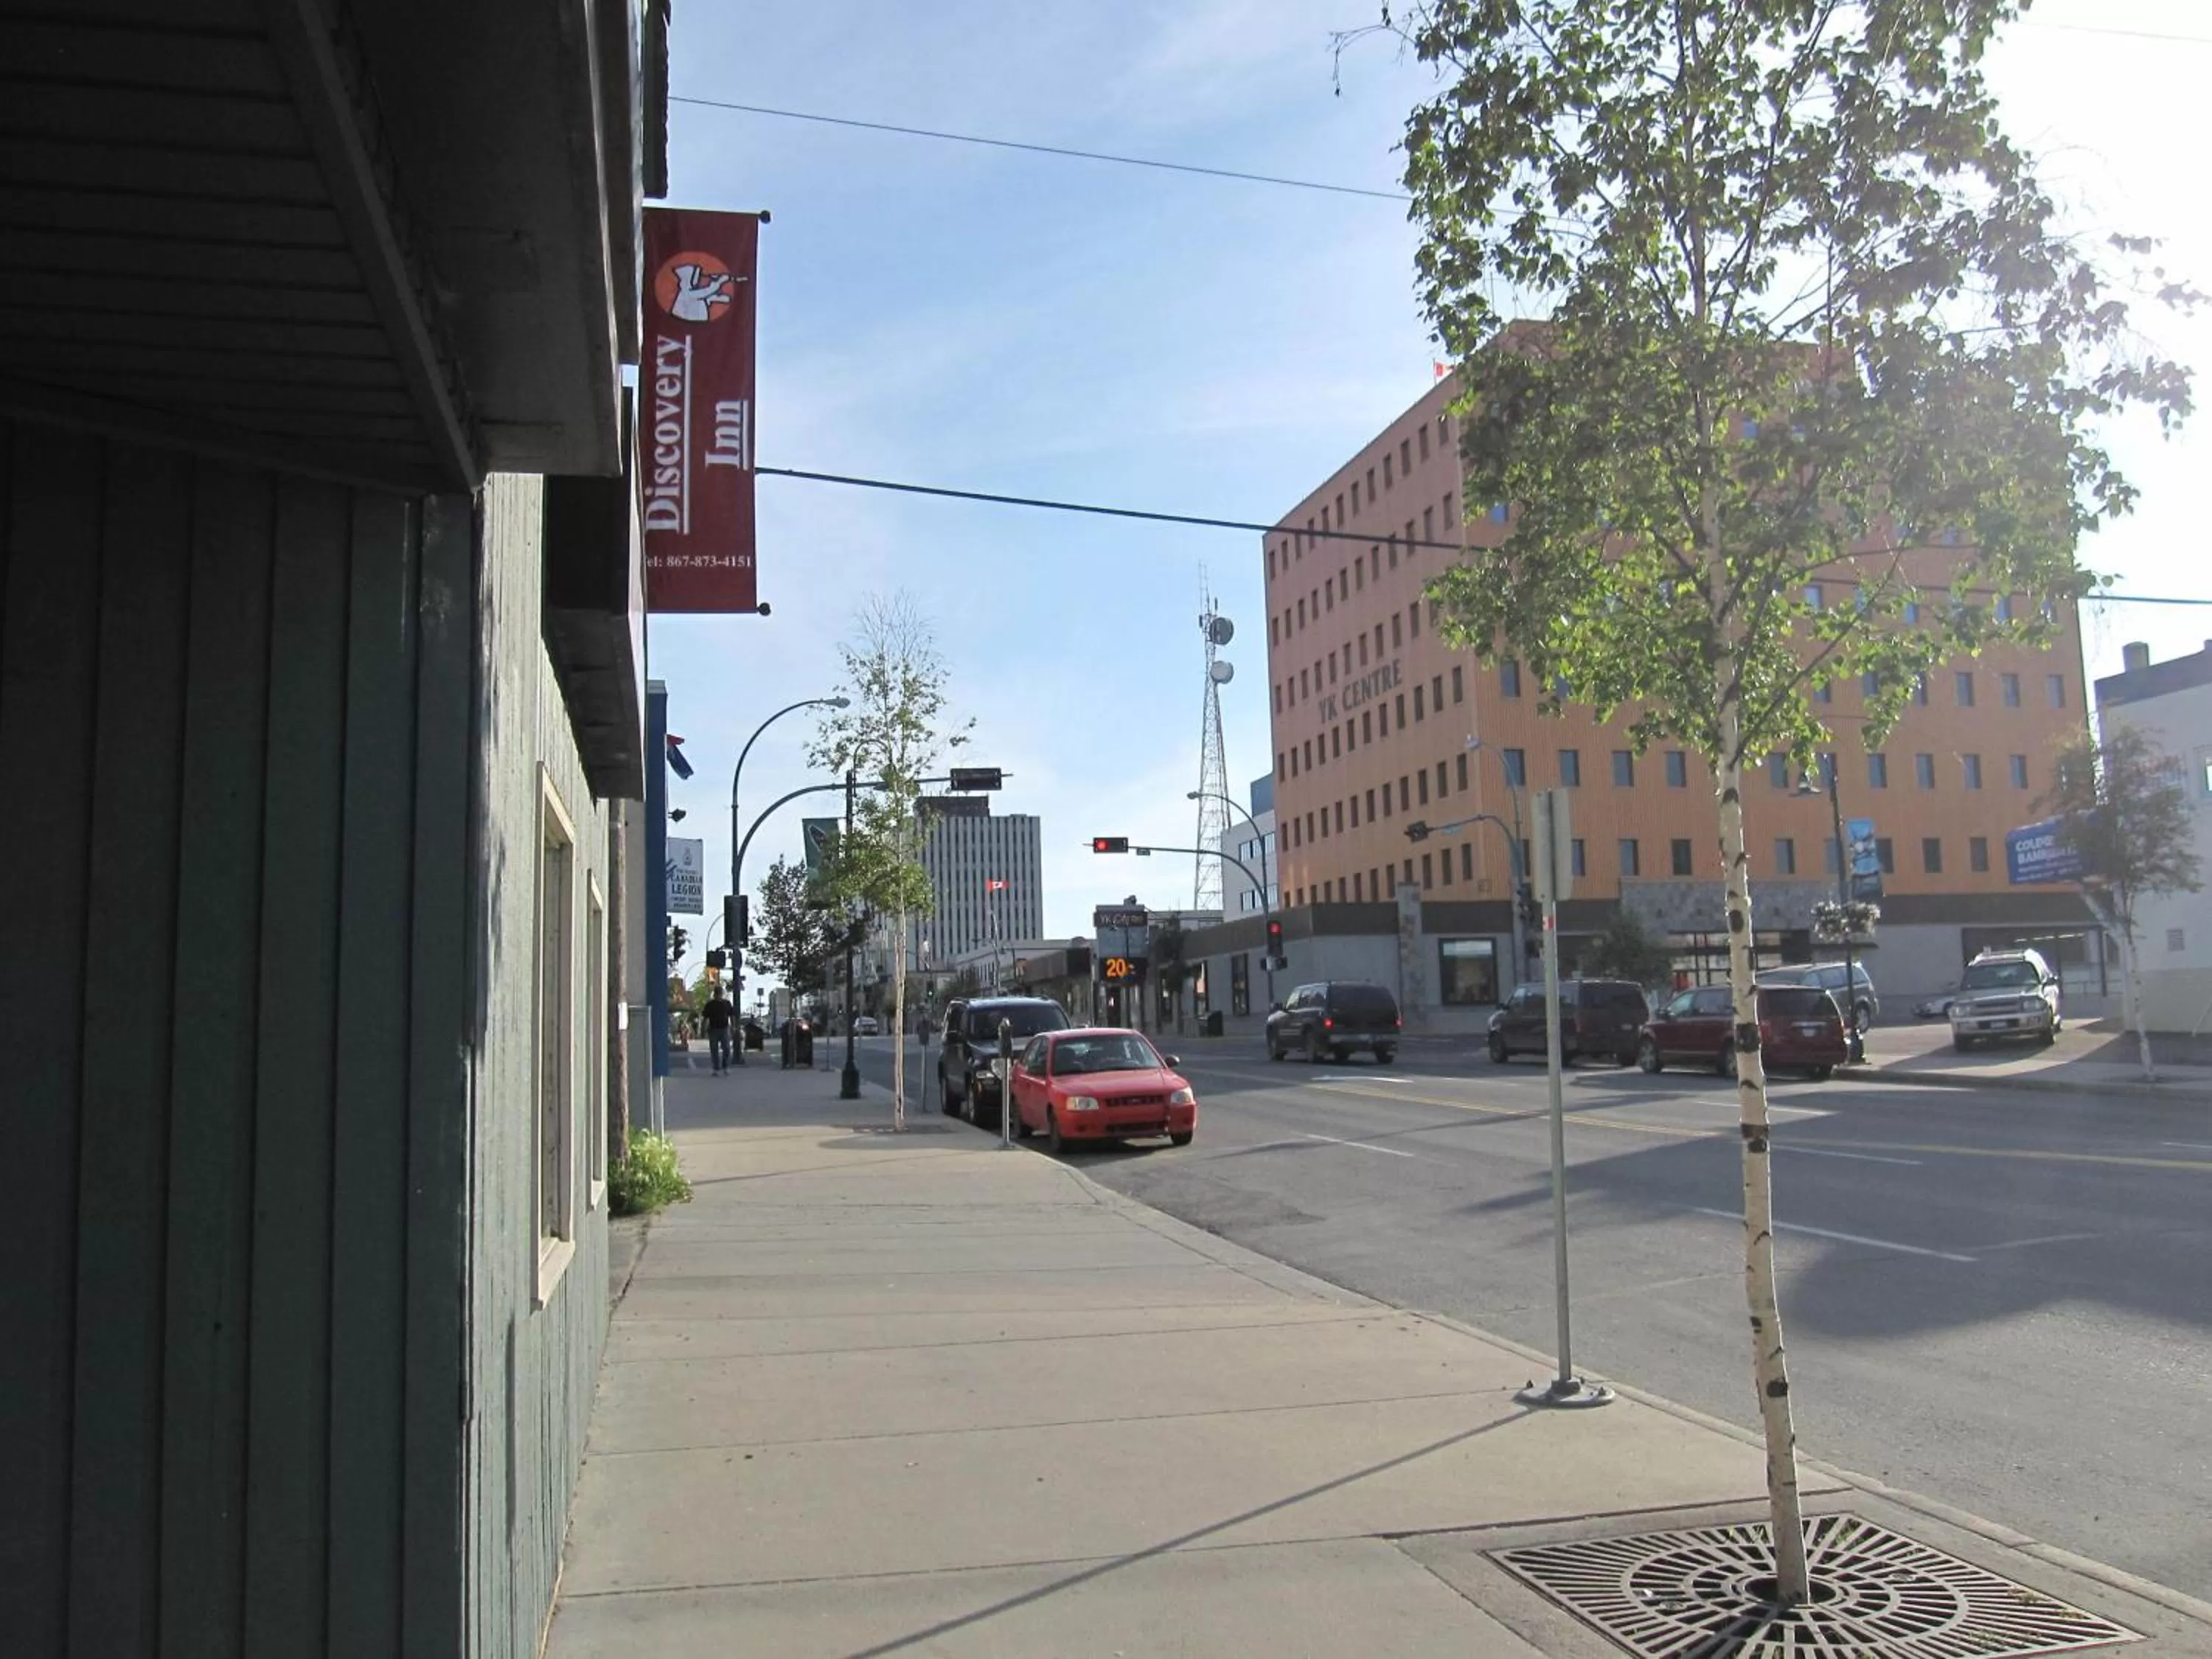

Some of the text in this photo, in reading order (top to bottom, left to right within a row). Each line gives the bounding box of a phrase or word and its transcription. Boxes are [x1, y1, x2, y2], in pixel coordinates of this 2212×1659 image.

[645, 334, 693, 535] Discovery
[705, 399, 749, 470] Inn
[644, 554, 751, 567] el: 867-873-4151
[1342, 658, 1402, 711] CENTRE
[672, 883, 702, 895] LEGION
